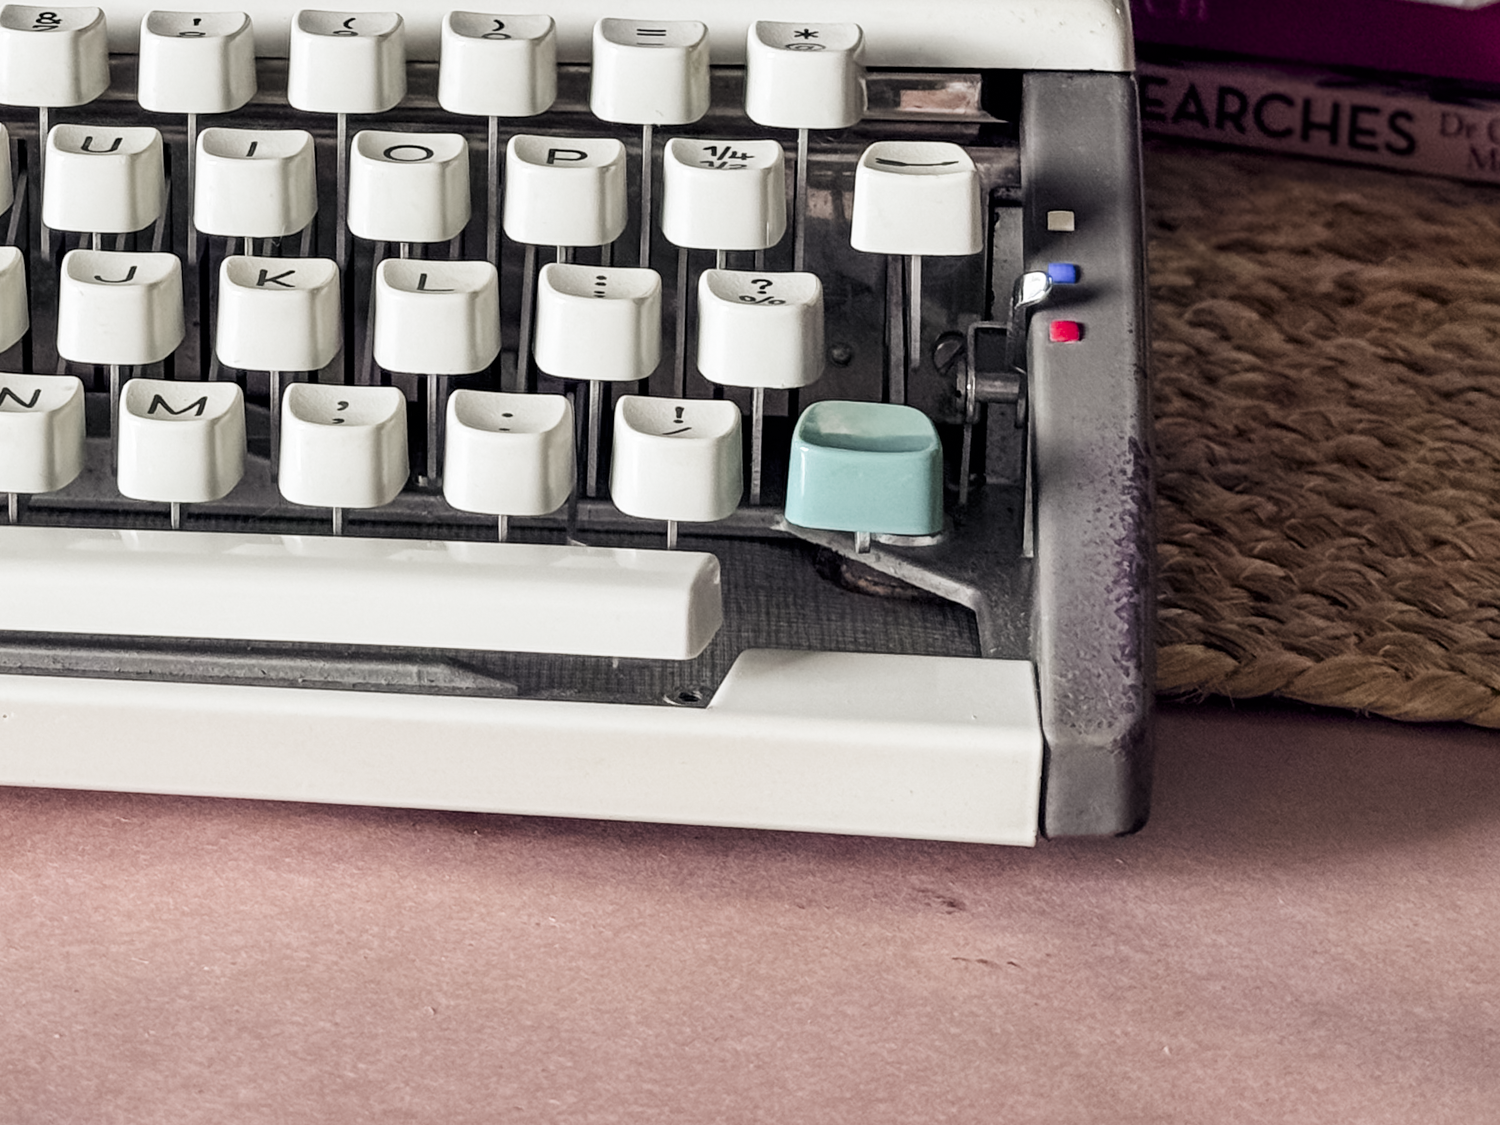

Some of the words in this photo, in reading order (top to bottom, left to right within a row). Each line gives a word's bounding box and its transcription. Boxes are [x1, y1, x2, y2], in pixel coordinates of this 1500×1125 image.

[35, 11, 62, 25] &
[1440, 111, 1478, 140] Dr
[80, 135, 123, 153] U
[382, 144, 434, 162] O
[546, 148, 588, 165] P
[93, 265, 138, 284] J
[255, 268, 296, 288] K
[416, 273, 454, 292] L
[146, 393, 208, 417] M
